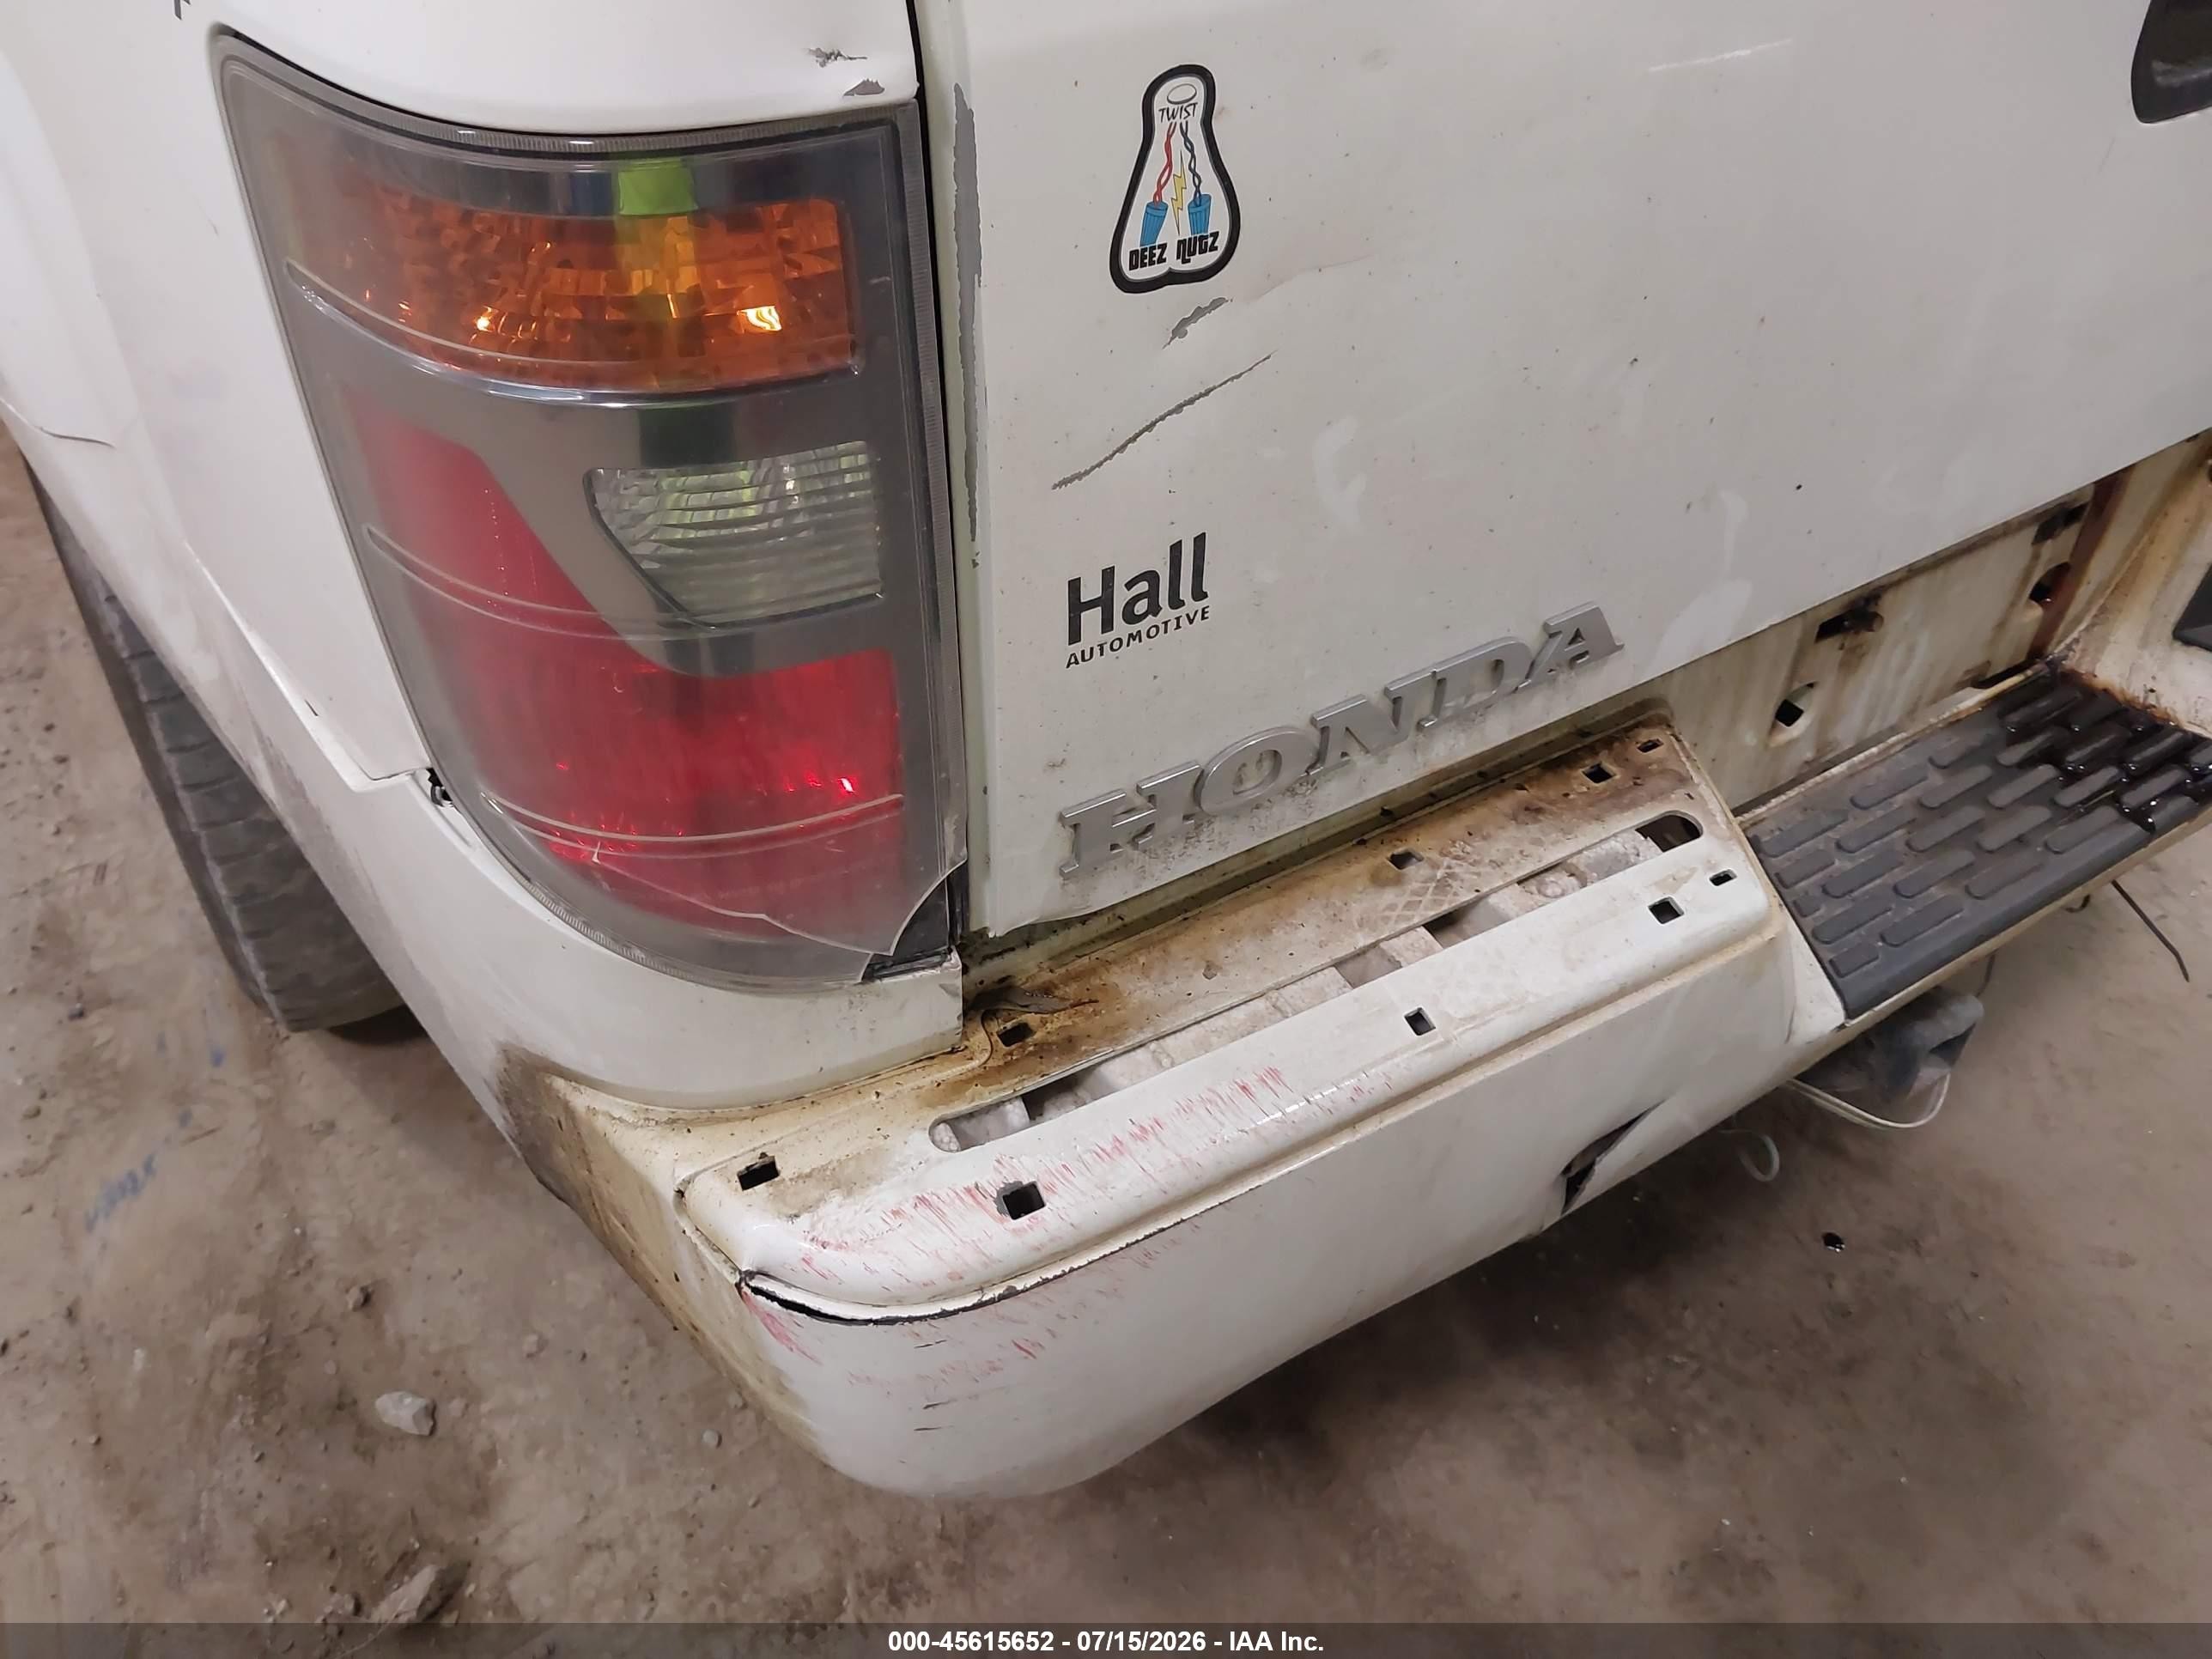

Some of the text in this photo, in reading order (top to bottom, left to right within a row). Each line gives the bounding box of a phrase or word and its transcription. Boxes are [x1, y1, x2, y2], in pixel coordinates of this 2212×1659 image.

[1158, 102, 1198, 123] TWIST
[1128, 242, 1168, 271] DEEZ
[1067, 532, 1208, 646] Hall
[1066, 605, 1210, 669] AUTOMOTIVE
[1060, 601, 1624, 878] HONDA
